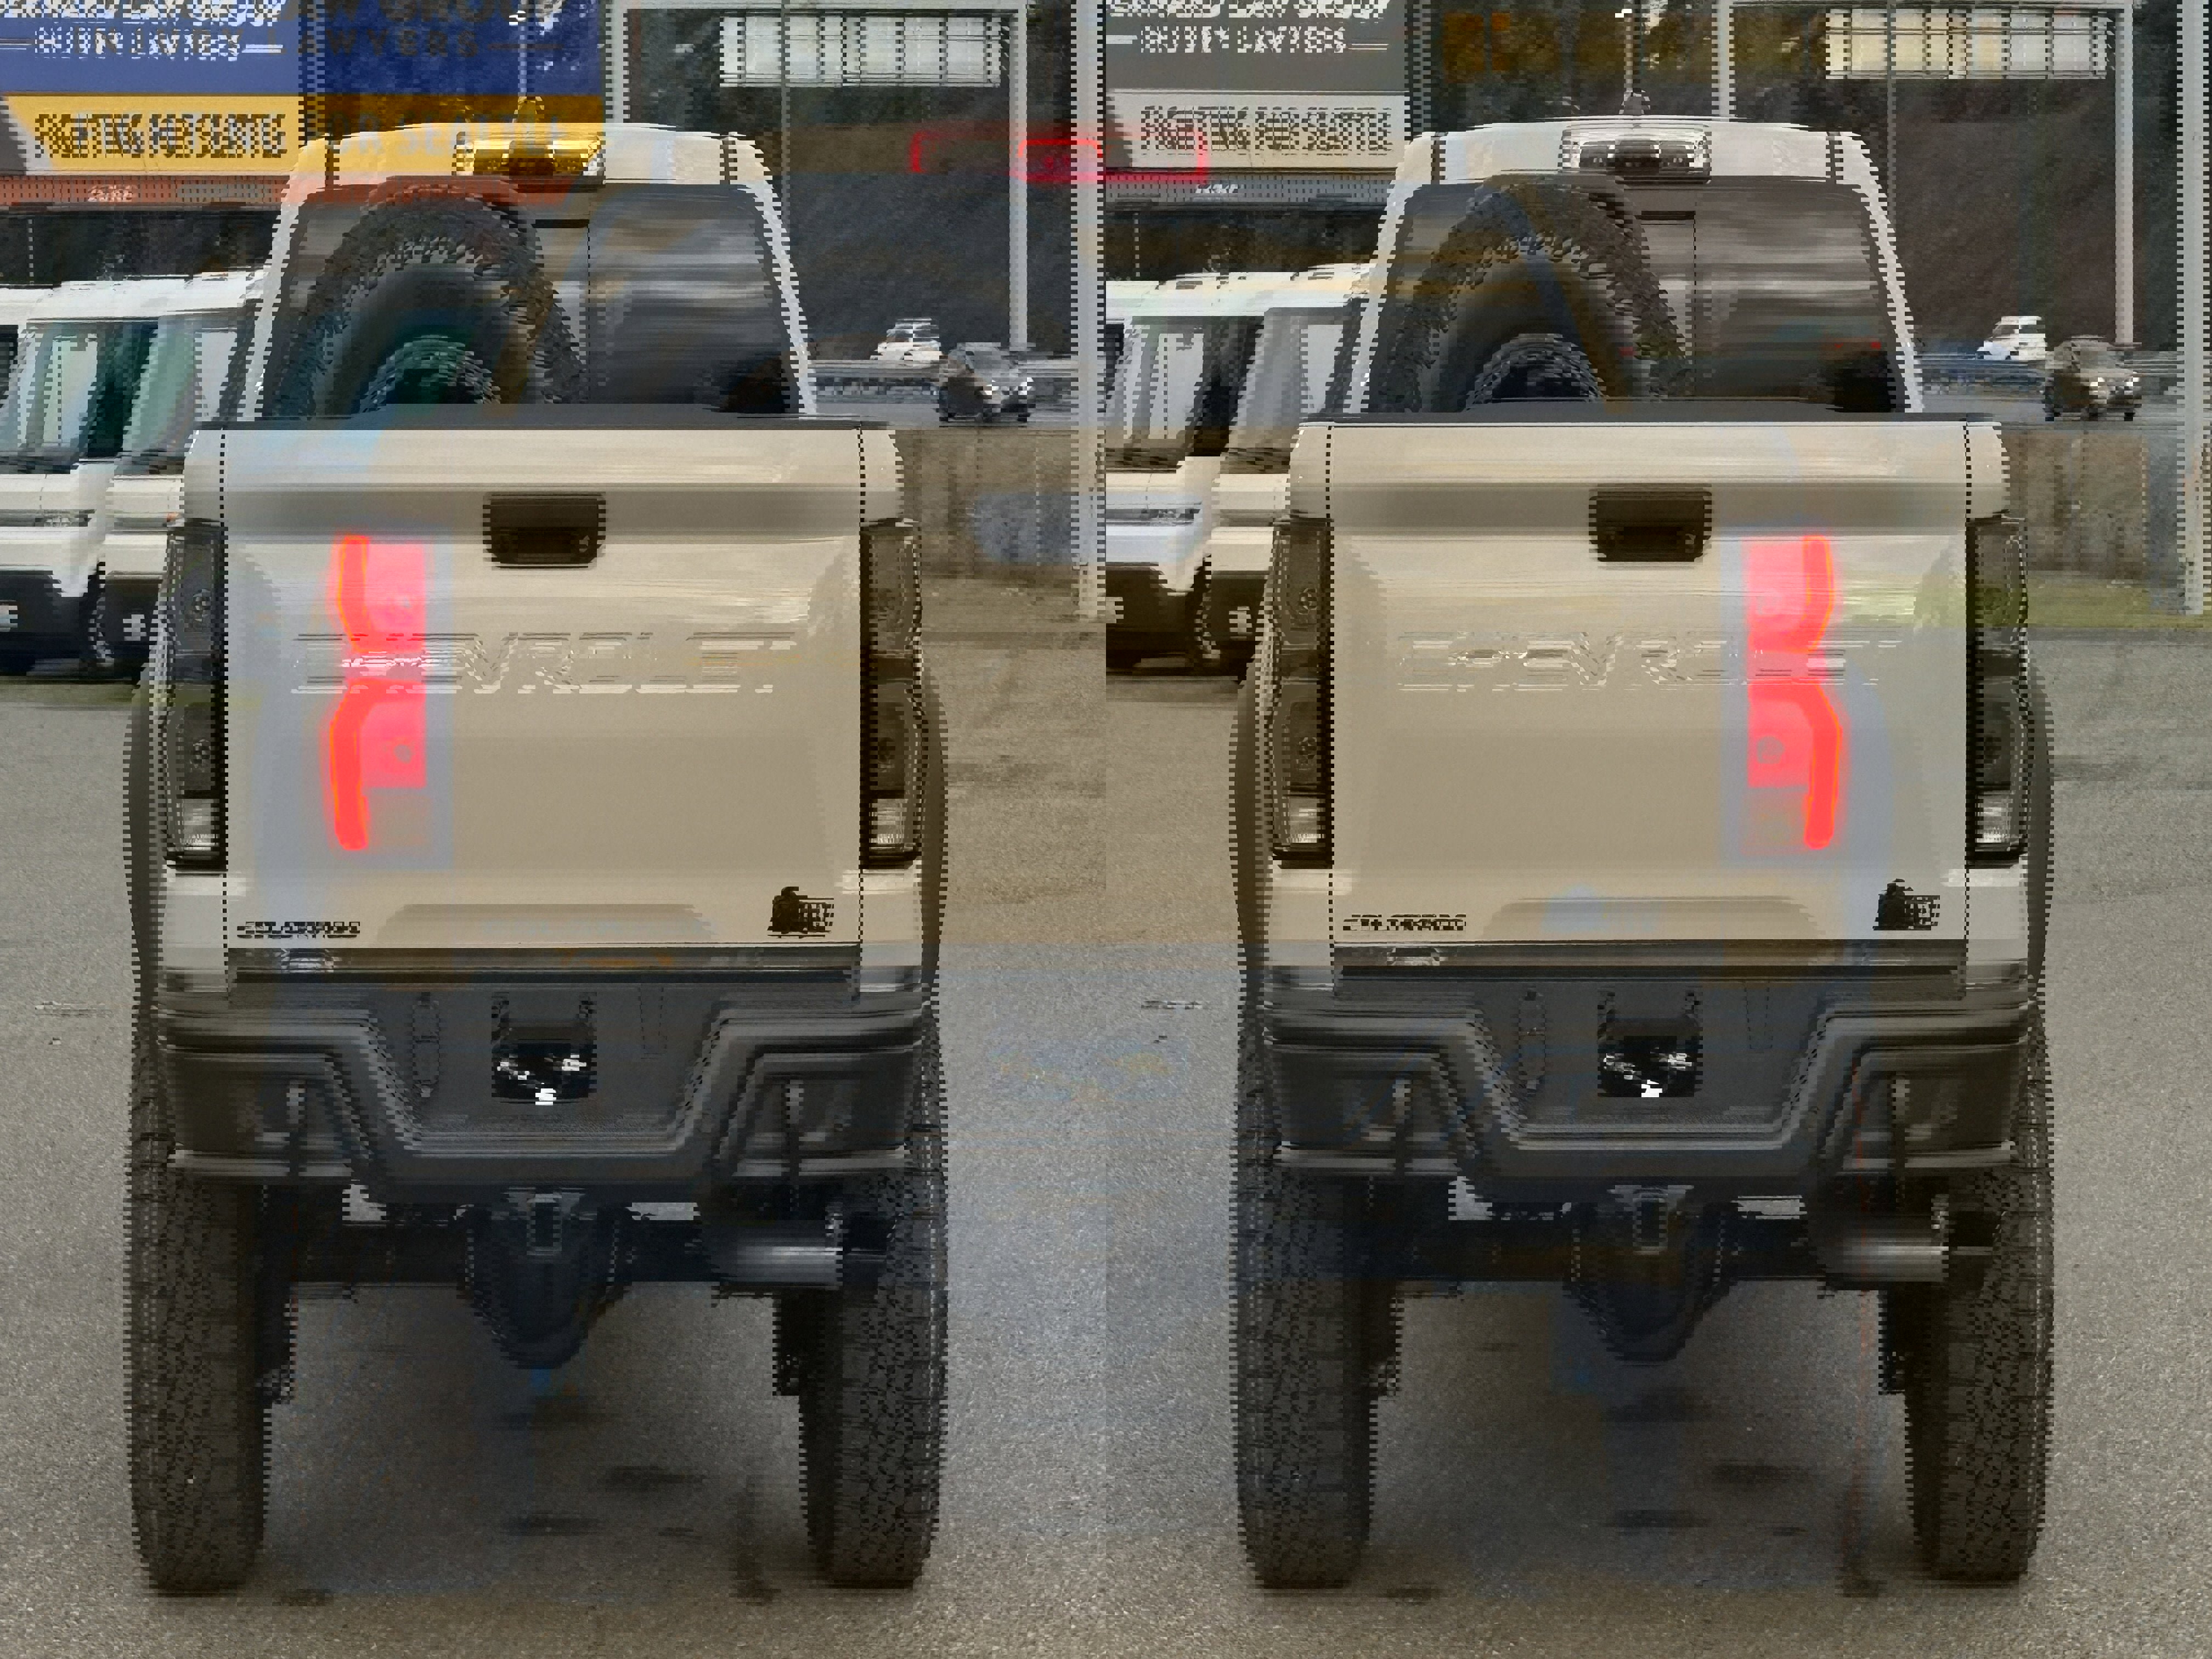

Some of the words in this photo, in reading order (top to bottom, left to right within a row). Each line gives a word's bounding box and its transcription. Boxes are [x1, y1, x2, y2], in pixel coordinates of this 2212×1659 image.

[74, 26, 244, 55] INJURY
[268, 28, 477, 57] LAWYERS
[74, 110, 285, 155] FIGHTING
[301, 111, 384, 156] FOR
[397, 111, 568, 156] SEATTLE
[589, 632, 1587, 691] CHEVROLET
[483, 918, 717, 935] COLORADO
